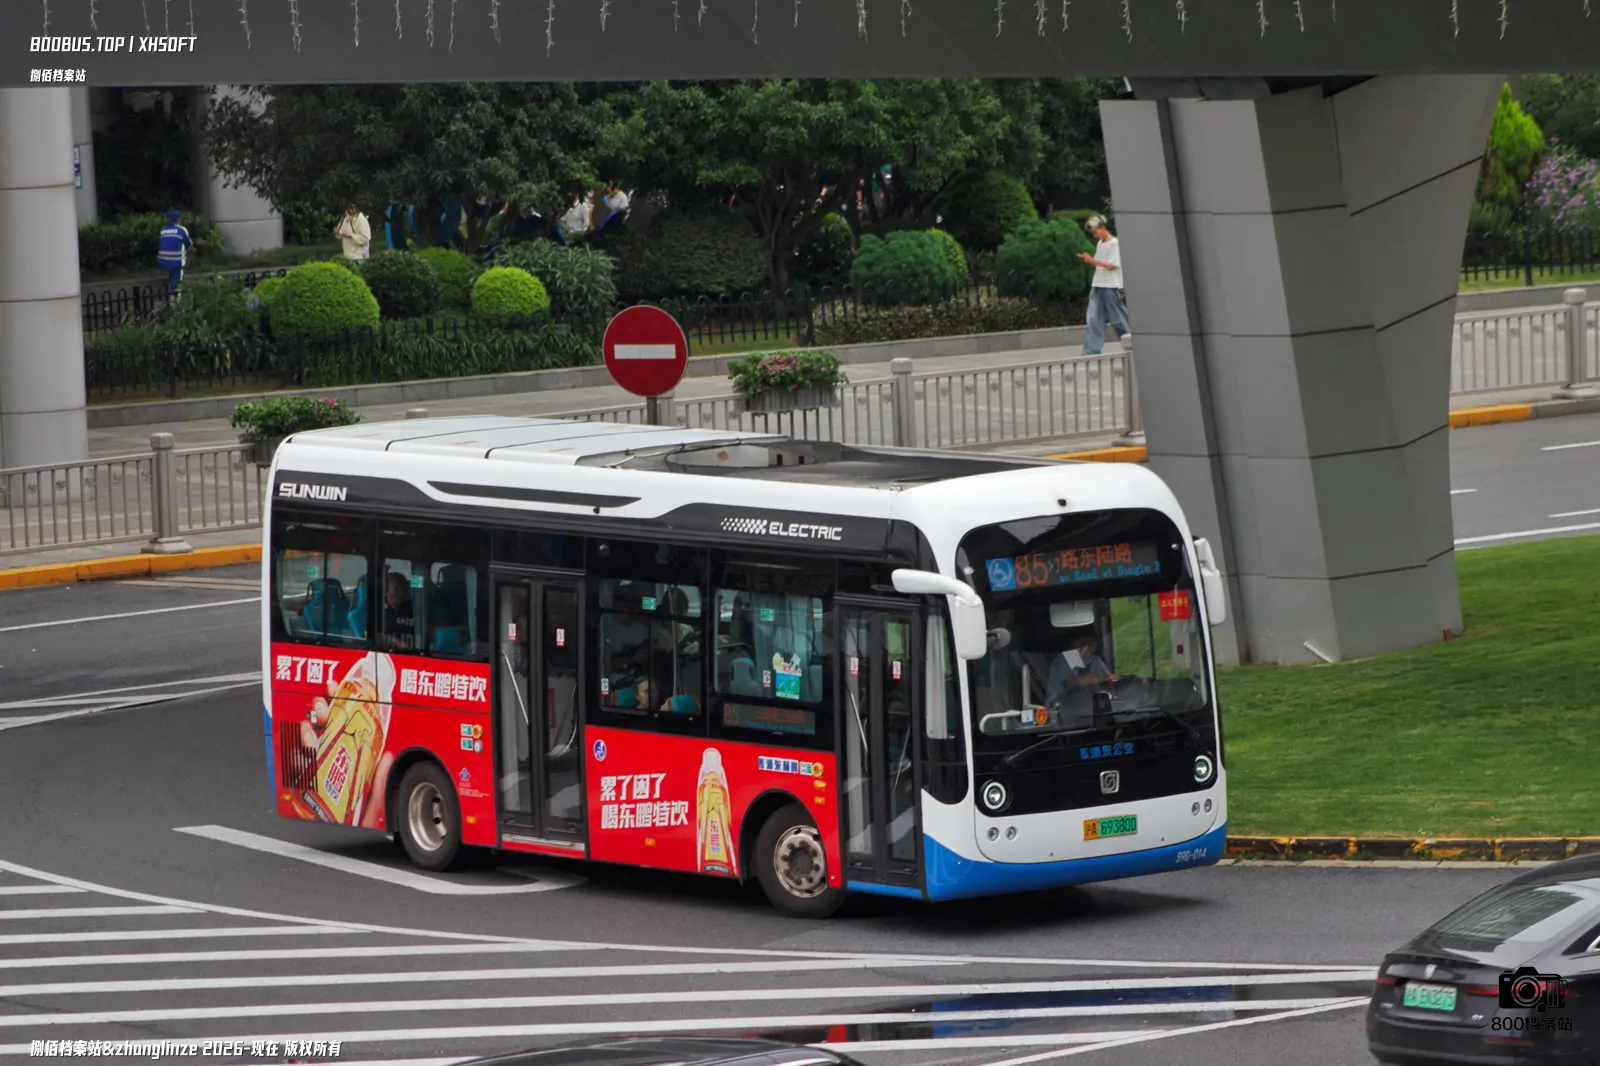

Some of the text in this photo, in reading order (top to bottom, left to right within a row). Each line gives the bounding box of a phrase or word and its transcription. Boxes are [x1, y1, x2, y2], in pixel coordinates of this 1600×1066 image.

[279, 482, 347, 501] SUNWIN
[769, 521, 843, 540] ELECTRIC
[1014, 543, 1132, 587] 85 路东陆路
[276, 655, 340, 684] 累了困了
[400, 667, 488, 702] 喝东鹏特饮
[600, 772, 667, 801] 累了困了
[601, 799, 689, 829] 喝东鹏特饮
